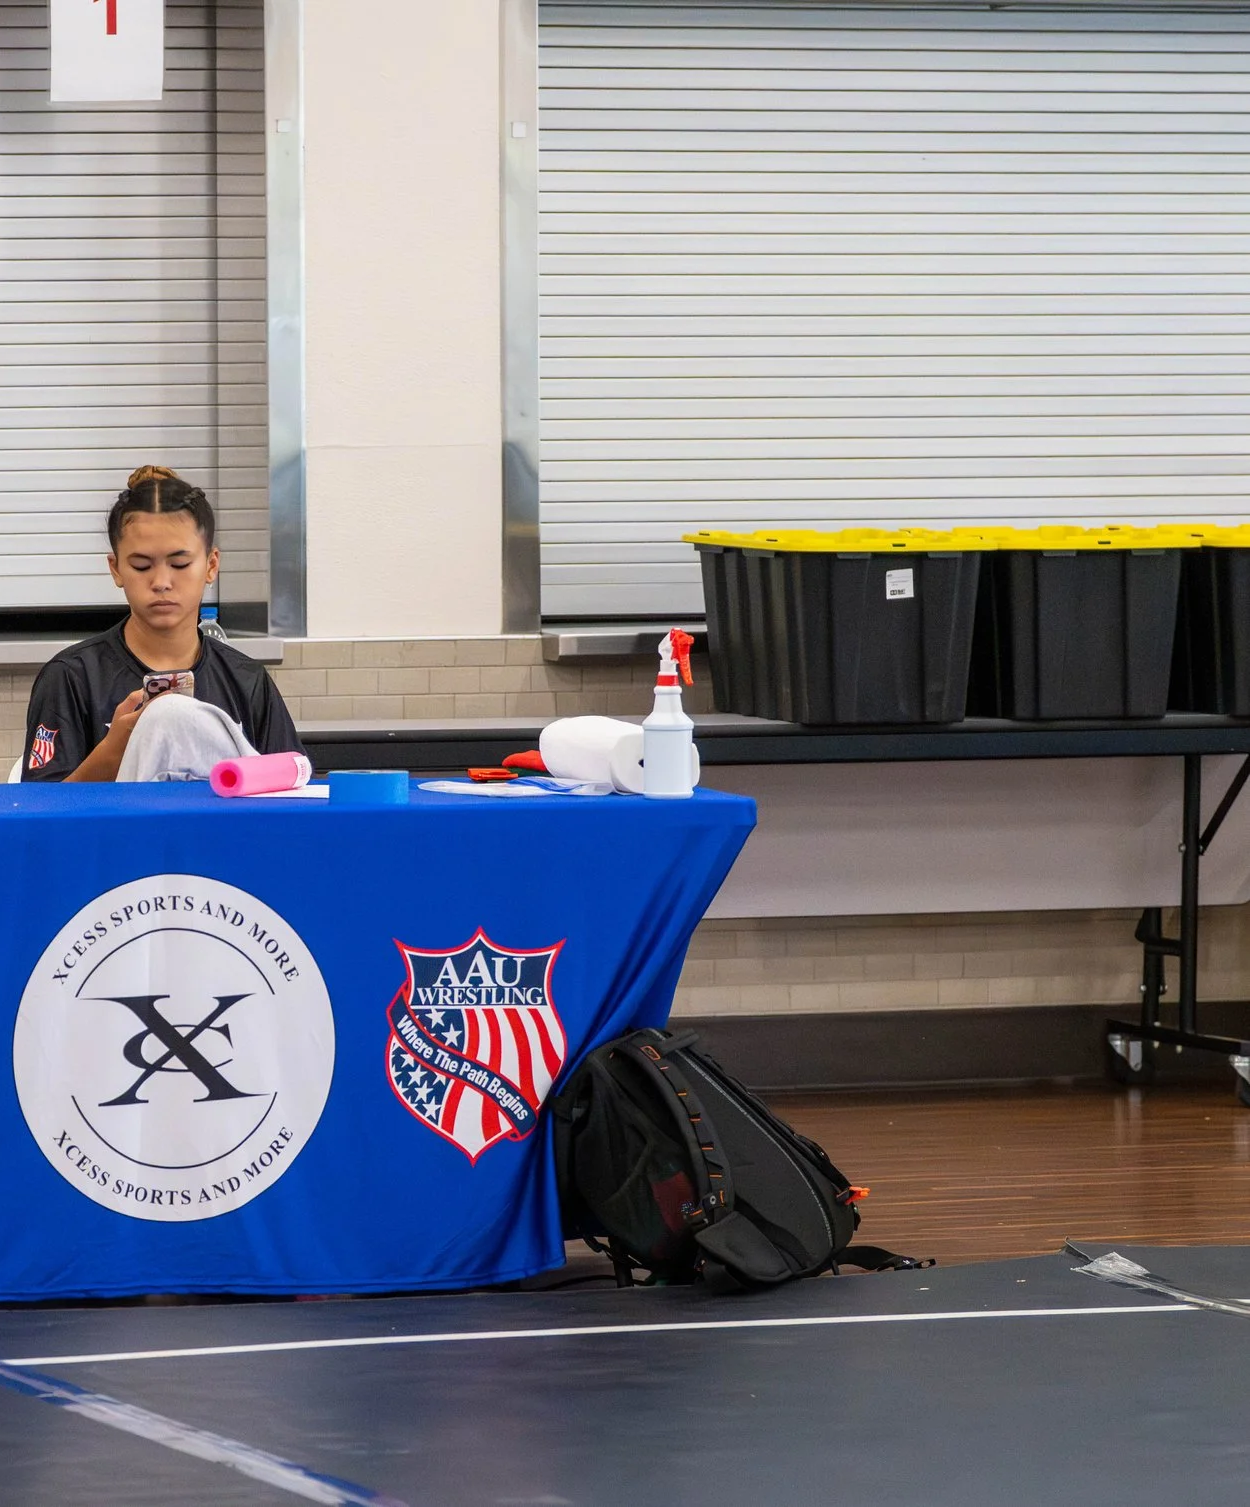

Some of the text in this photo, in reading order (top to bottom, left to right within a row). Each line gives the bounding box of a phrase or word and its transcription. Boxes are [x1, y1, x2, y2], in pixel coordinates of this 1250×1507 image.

[93, 0, 117, 35] 1
[52, 894, 300, 985] XCESS SPORTS AND MORE
[432, 950, 526, 988] AAU
[416, 986, 543, 1006] WRESTLING
[396, 1014, 529, 1121] Where The Path Begins
[53, 1126, 294, 1206] XCESS SPORTS AND MORE
